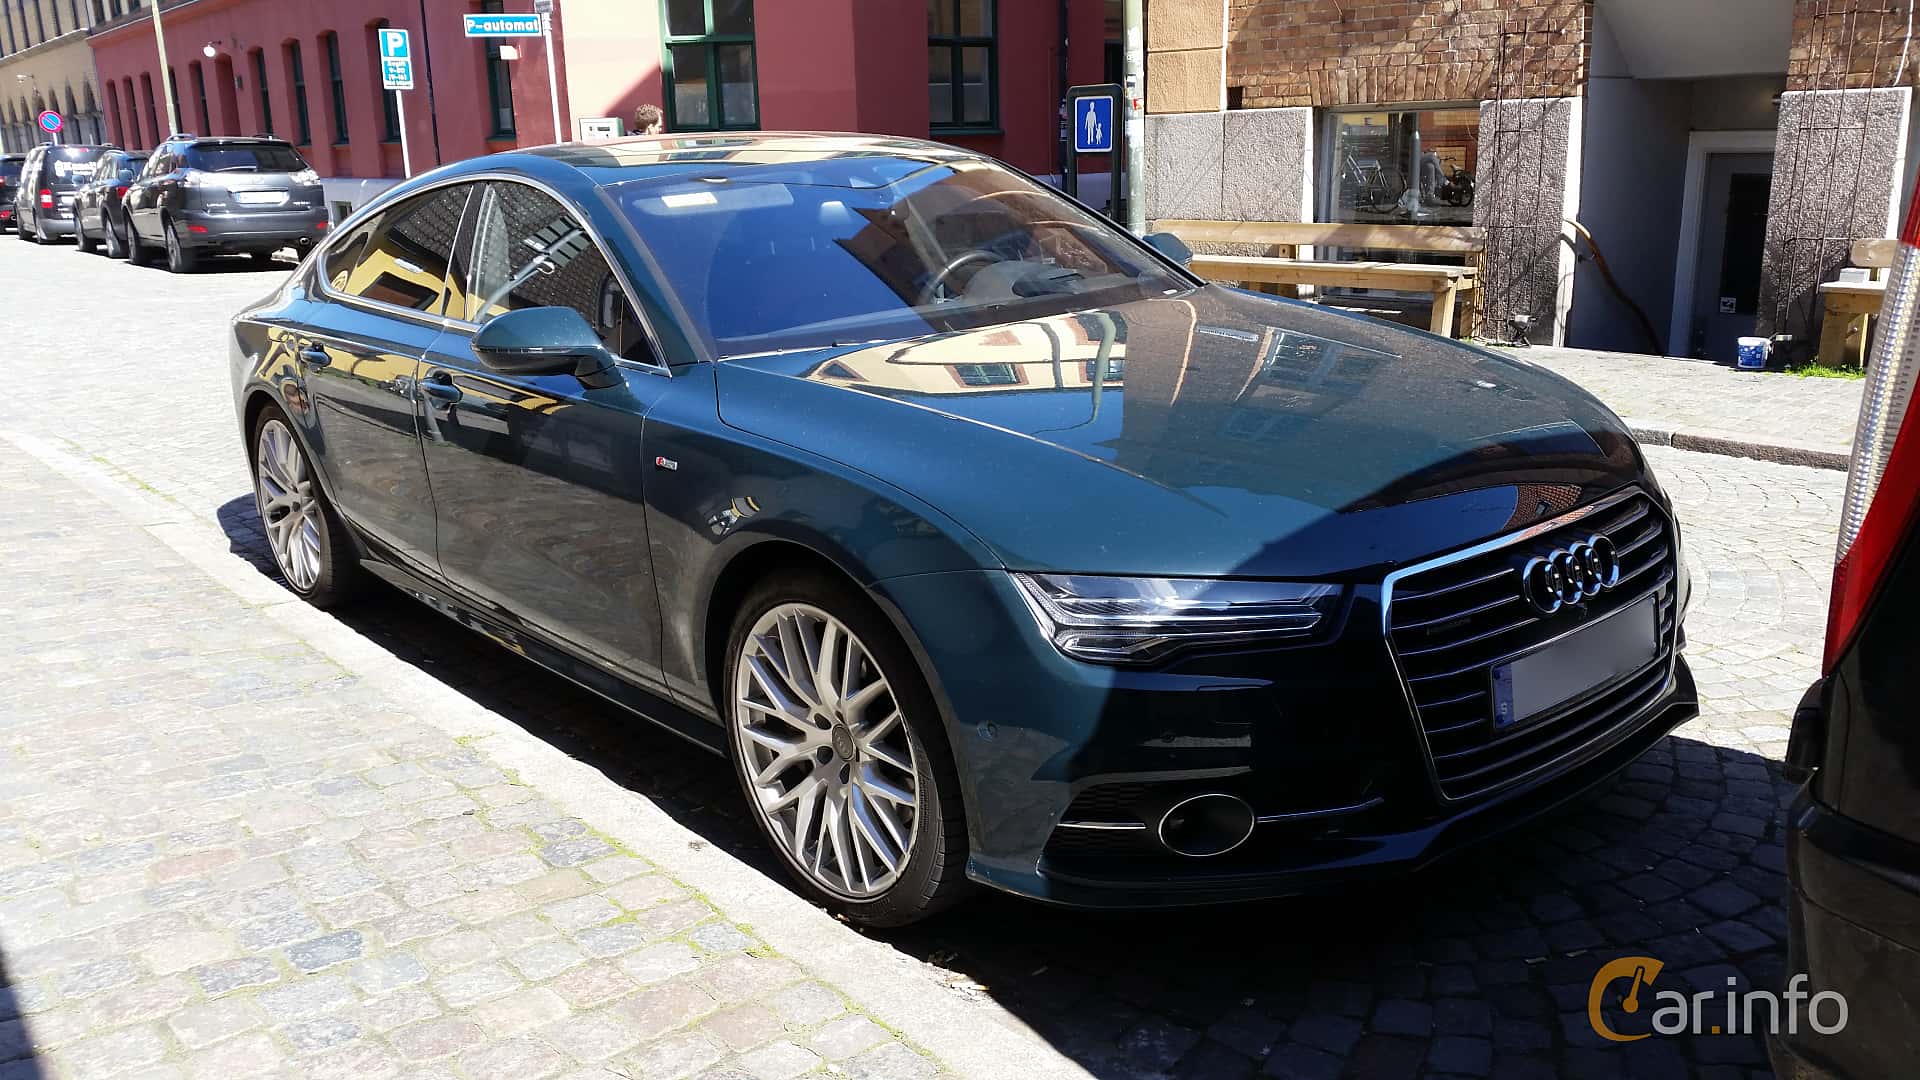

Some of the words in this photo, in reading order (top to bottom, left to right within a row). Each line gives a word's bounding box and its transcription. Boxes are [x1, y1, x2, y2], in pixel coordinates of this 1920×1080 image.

[466, 19, 539, 32] P-automat
[386, 32, 404, 57] P
[1501, 702, 1508, 714] S
